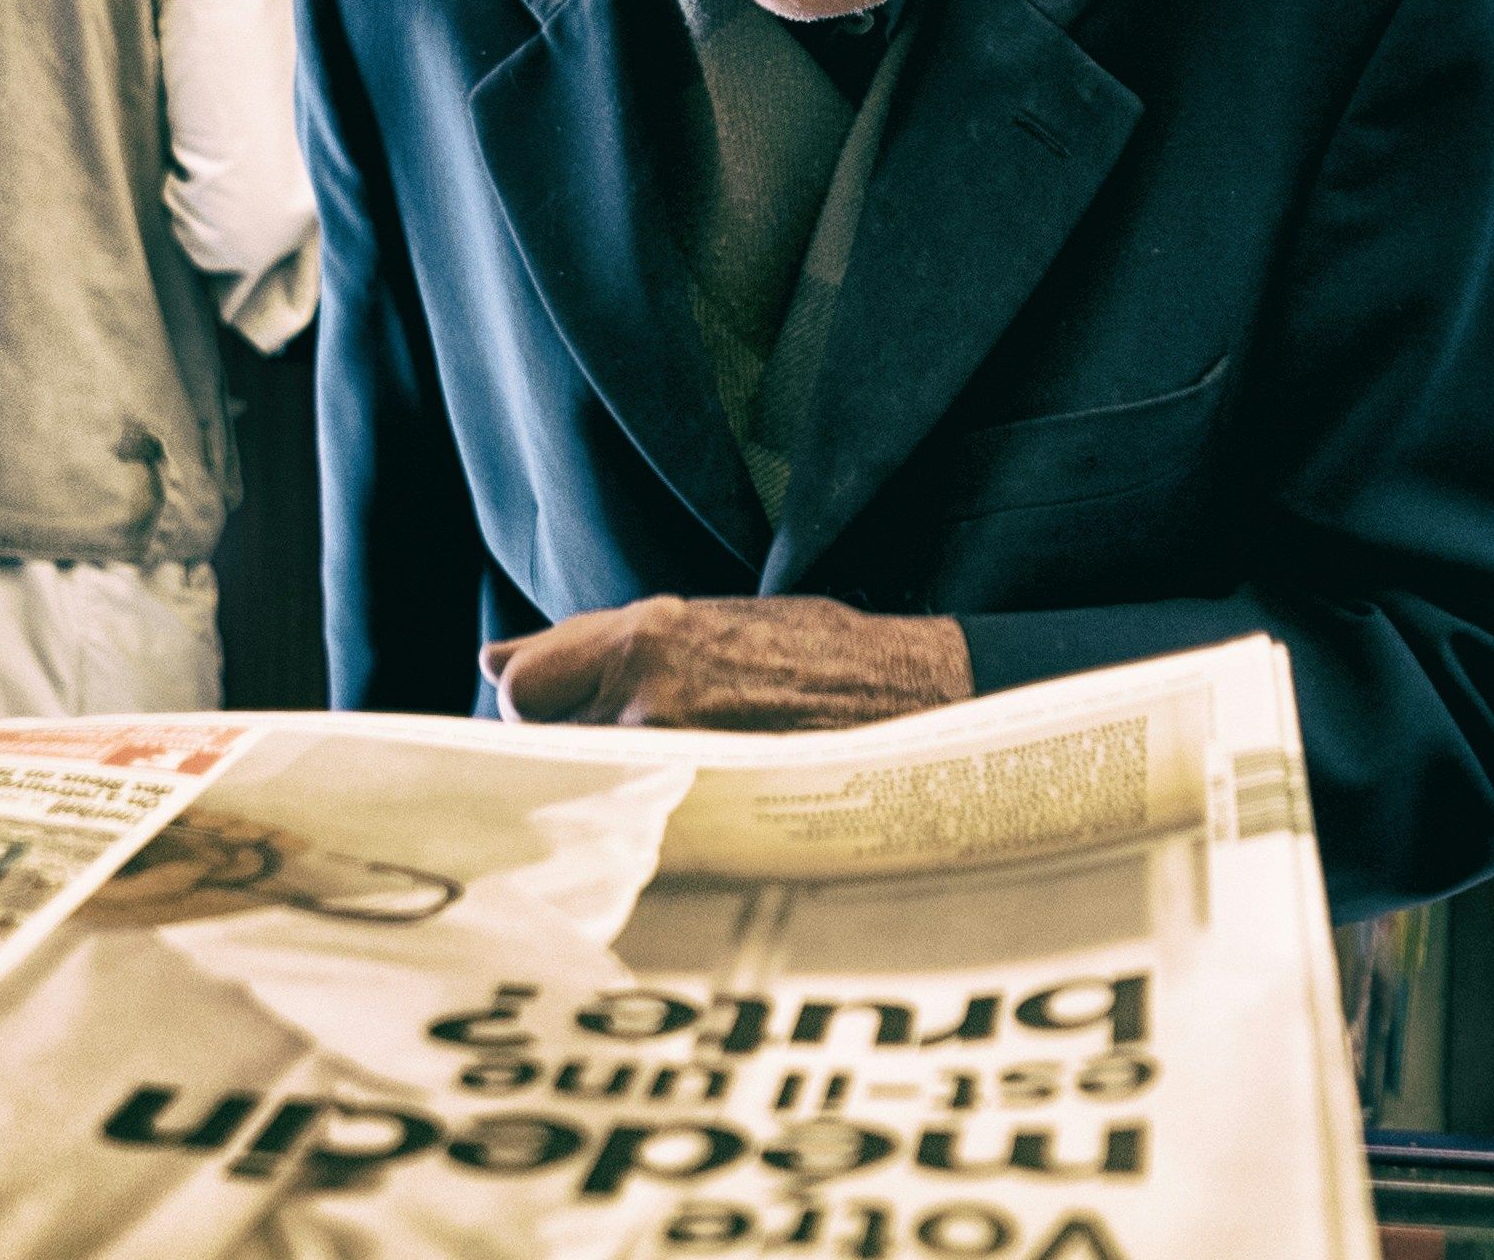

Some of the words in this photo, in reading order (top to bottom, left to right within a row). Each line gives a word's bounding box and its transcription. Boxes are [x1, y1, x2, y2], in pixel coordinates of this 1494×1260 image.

[426, 982, 541, 1048] ?
[574, 972, 1150, 1055] brute
[459, 1057, 731, 1103] une
[772, 1053, 1158, 1112] est-il
[101, 1084, 1151, 1202] médecin
